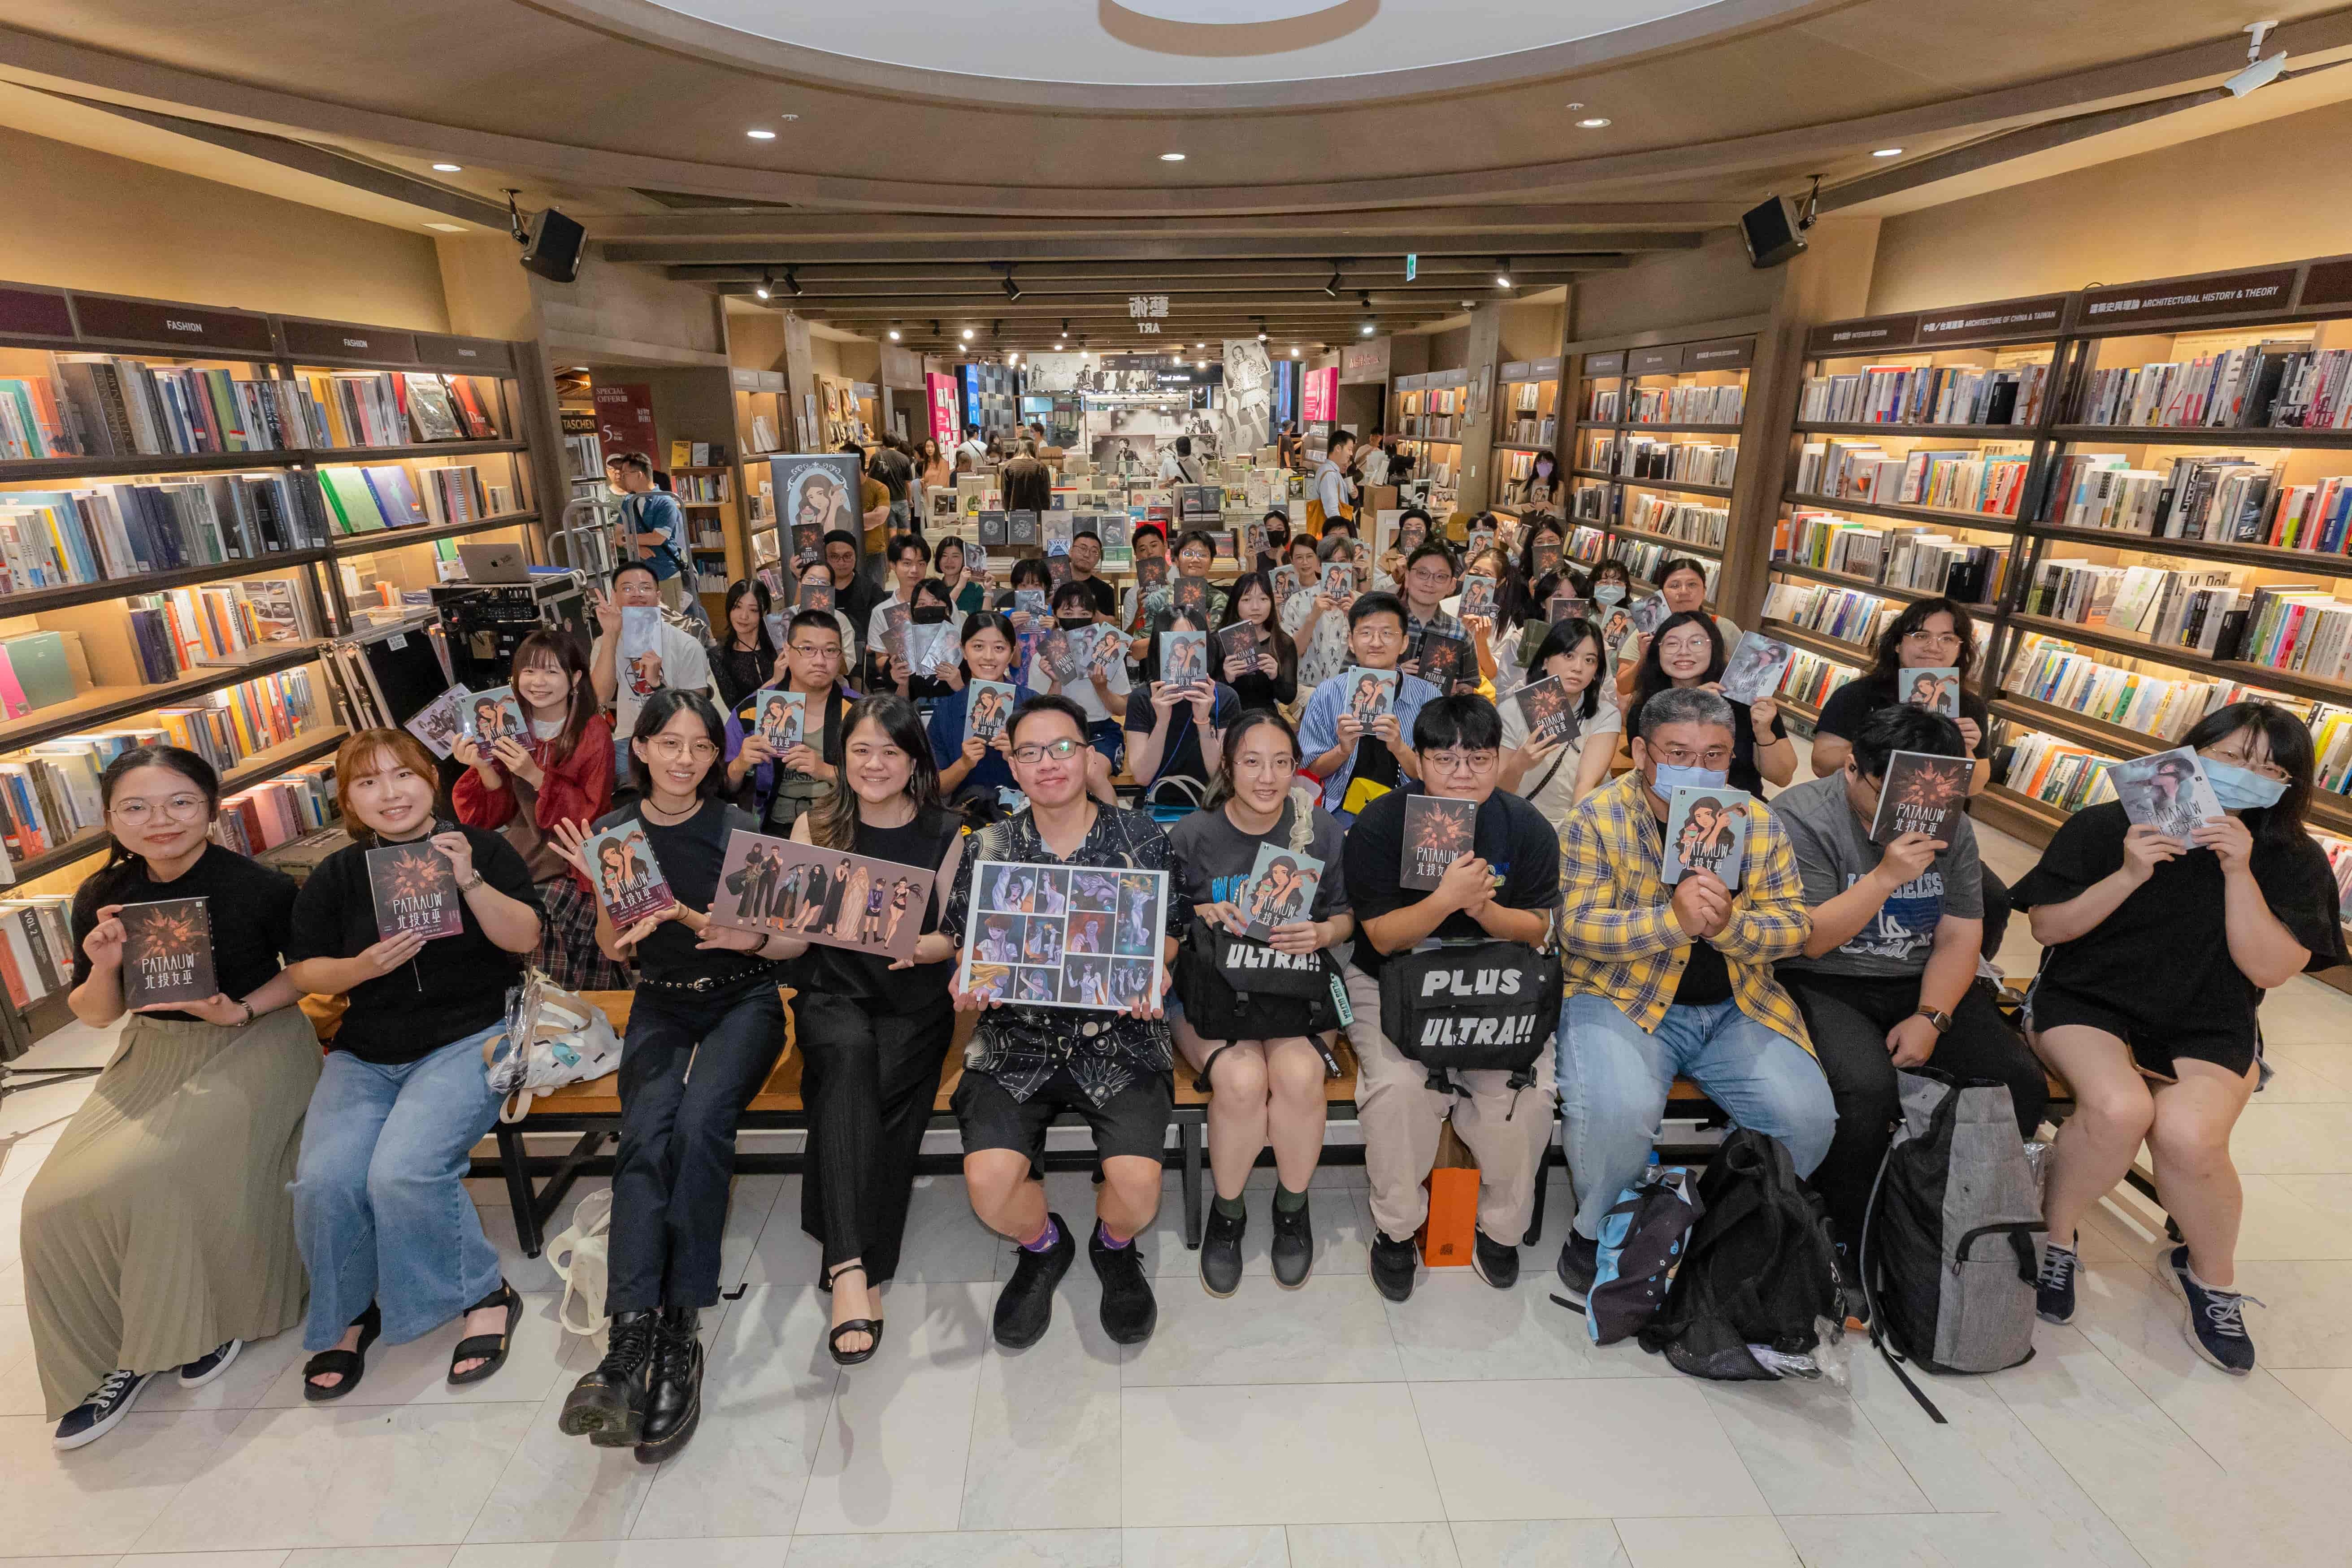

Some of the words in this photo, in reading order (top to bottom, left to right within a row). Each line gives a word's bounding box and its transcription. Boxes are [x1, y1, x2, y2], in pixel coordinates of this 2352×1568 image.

[2142, 294, 2200, 308] ARCHITECTURAL
[2202, 289, 2235, 301] HISTORY
[2236, 289, 2243, 298] &
[2245, 286, 2279, 298] THEORY
[167, 320, 203, 333] FASHION
[1965, 316, 2002, 327] ARCHITECTURE
[2011, 313, 2027, 322] CHINA
[2034, 311, 2056, 320] TAIWAN
[343, 338, 368, 348] FASHION
[596, 387, 625, 395] SPECIAL
[562, 419, 595, 430] TASCHEN
[226, 592, 239, 632] SKATEBOARD
[1896, 803, 1946, 823] PATAAUW
[2145, 800, 2202, 825] PATAAUW
[1893, 818, 1939, 836] 北投女巫
[1683, 841, 1729, 858] PATAAUW
[1416, 862, 1445, 877] 北投女
[609, 870, 649, 897] PATAAUW
[393, 892, 443, 915] PATAAUW
[618, 887, 653, 911] 北投女巫
[23, 911, 34, 929] VOL
[397, 908, 442, 930] 北投女巫
[142, 953, 195, 974] PATAAUW
[1225, 943, 1320, 972] ULTRA!!
[144, 969, 193, 990] 北投女巫
[1421, 968, 1523, 997] PLUS
[1332, 980, 1343, 998] PLUS
[1338, 995, 1352, 1020] ULTRA
[1420, 1014, 1536, 1046] ULTRA!!
